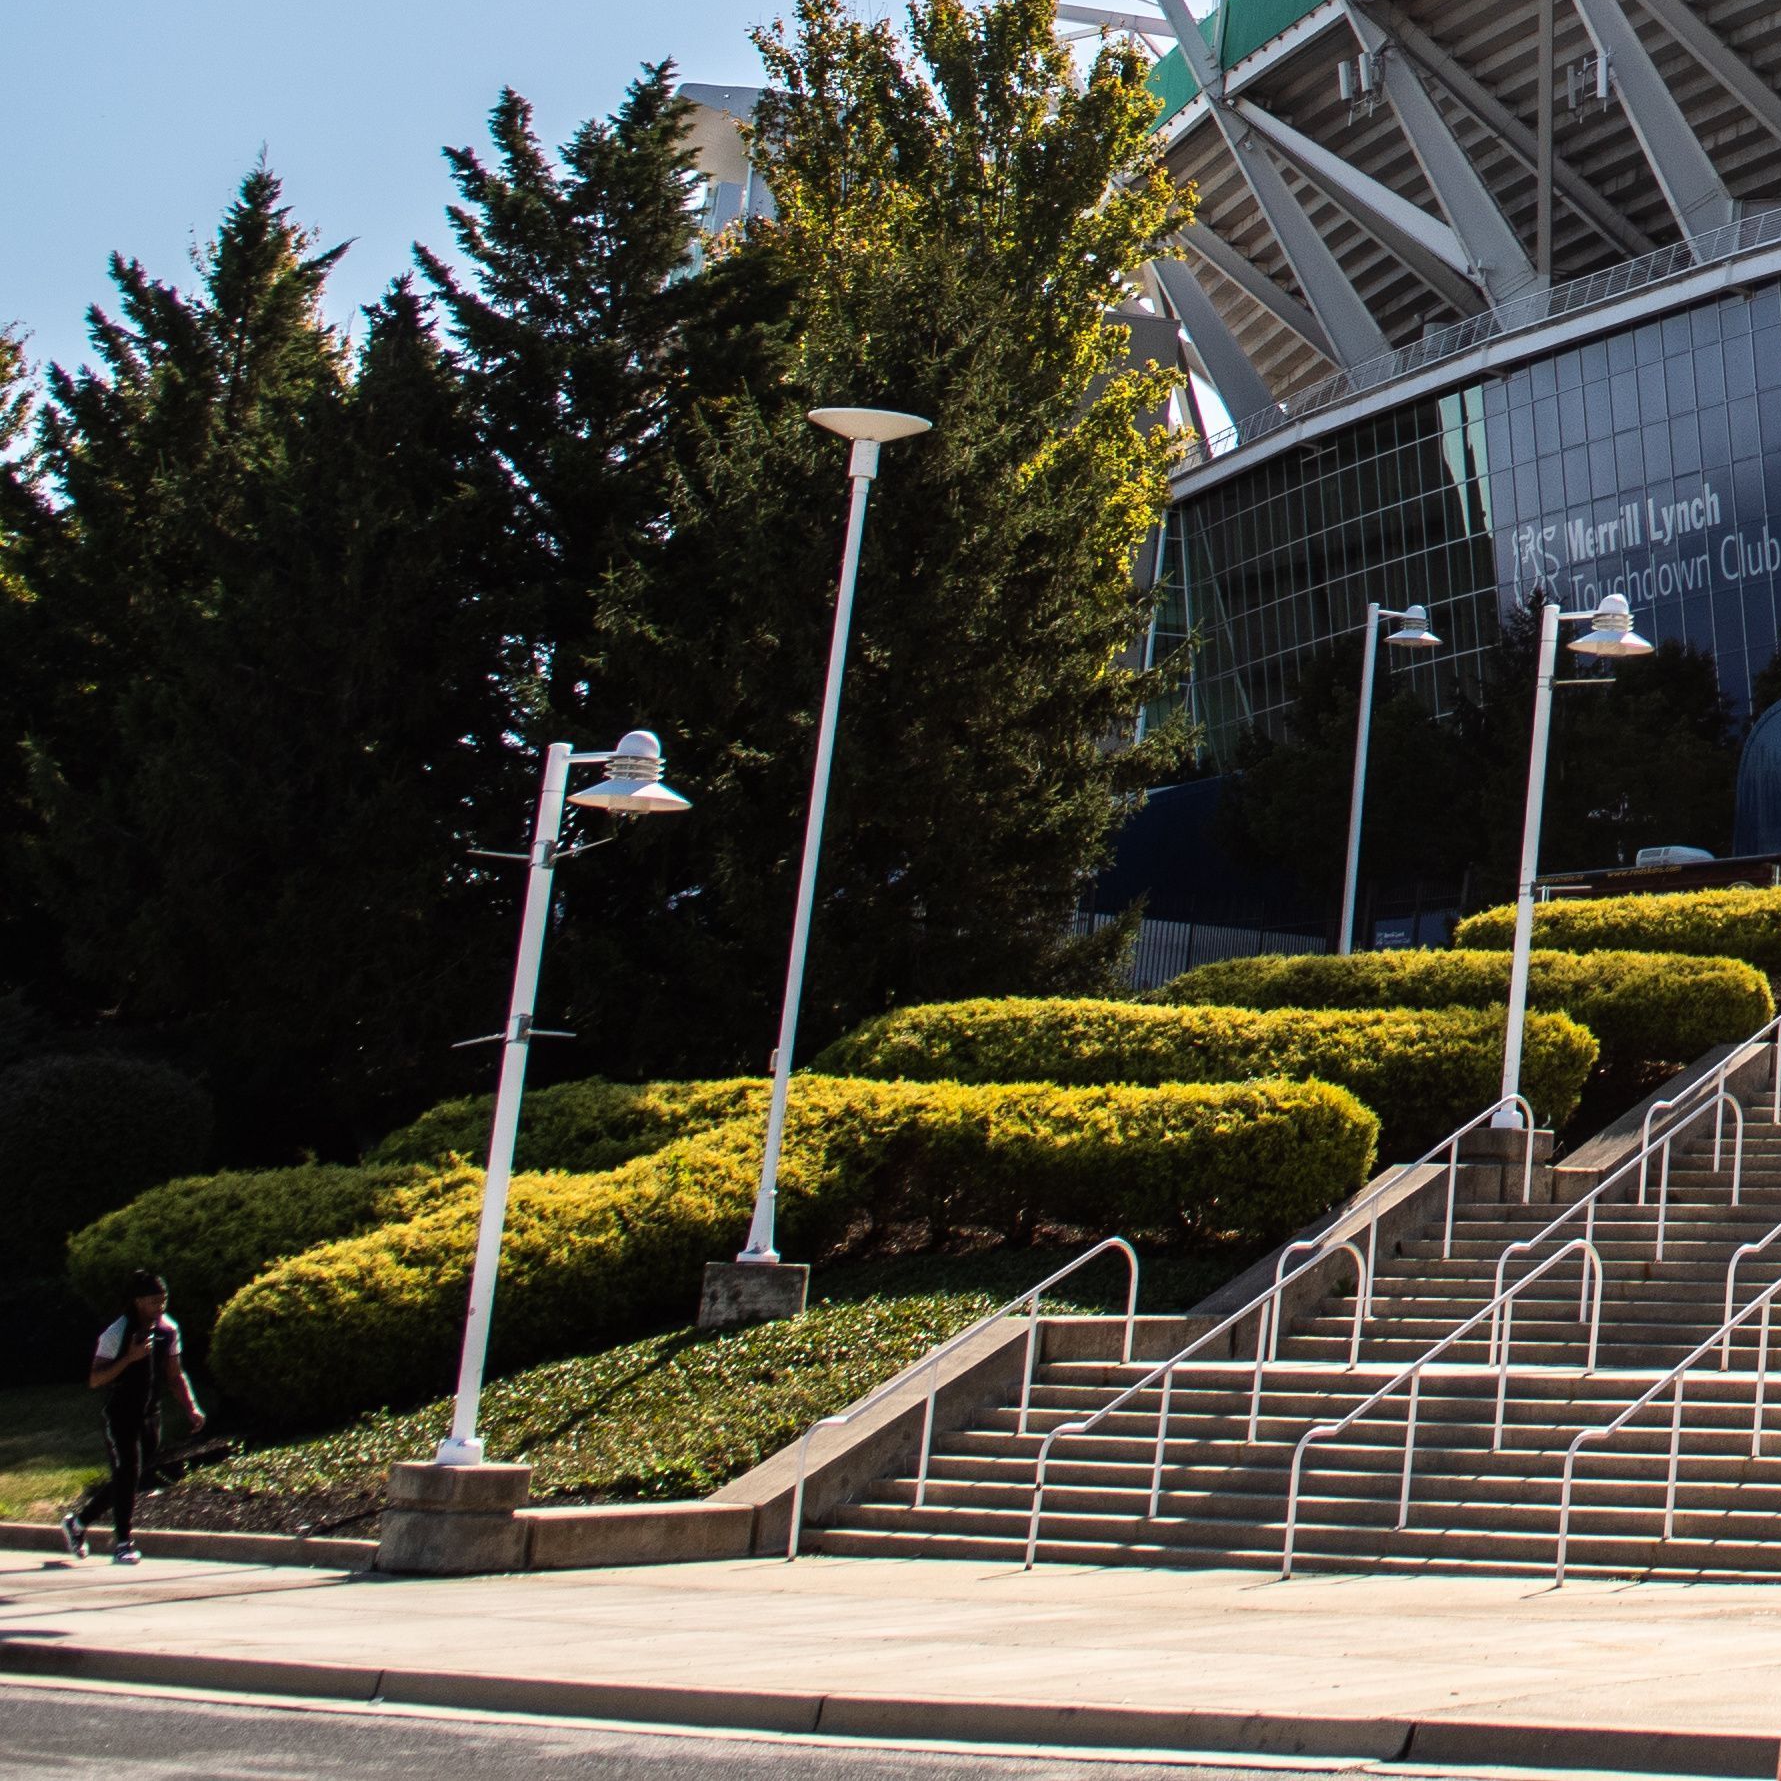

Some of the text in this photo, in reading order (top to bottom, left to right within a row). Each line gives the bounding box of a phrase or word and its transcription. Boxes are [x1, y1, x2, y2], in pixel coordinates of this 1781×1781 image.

[1565, 483, 1721, 562] Merrill Lynch
[1720, 524, 1781, 581] Club
